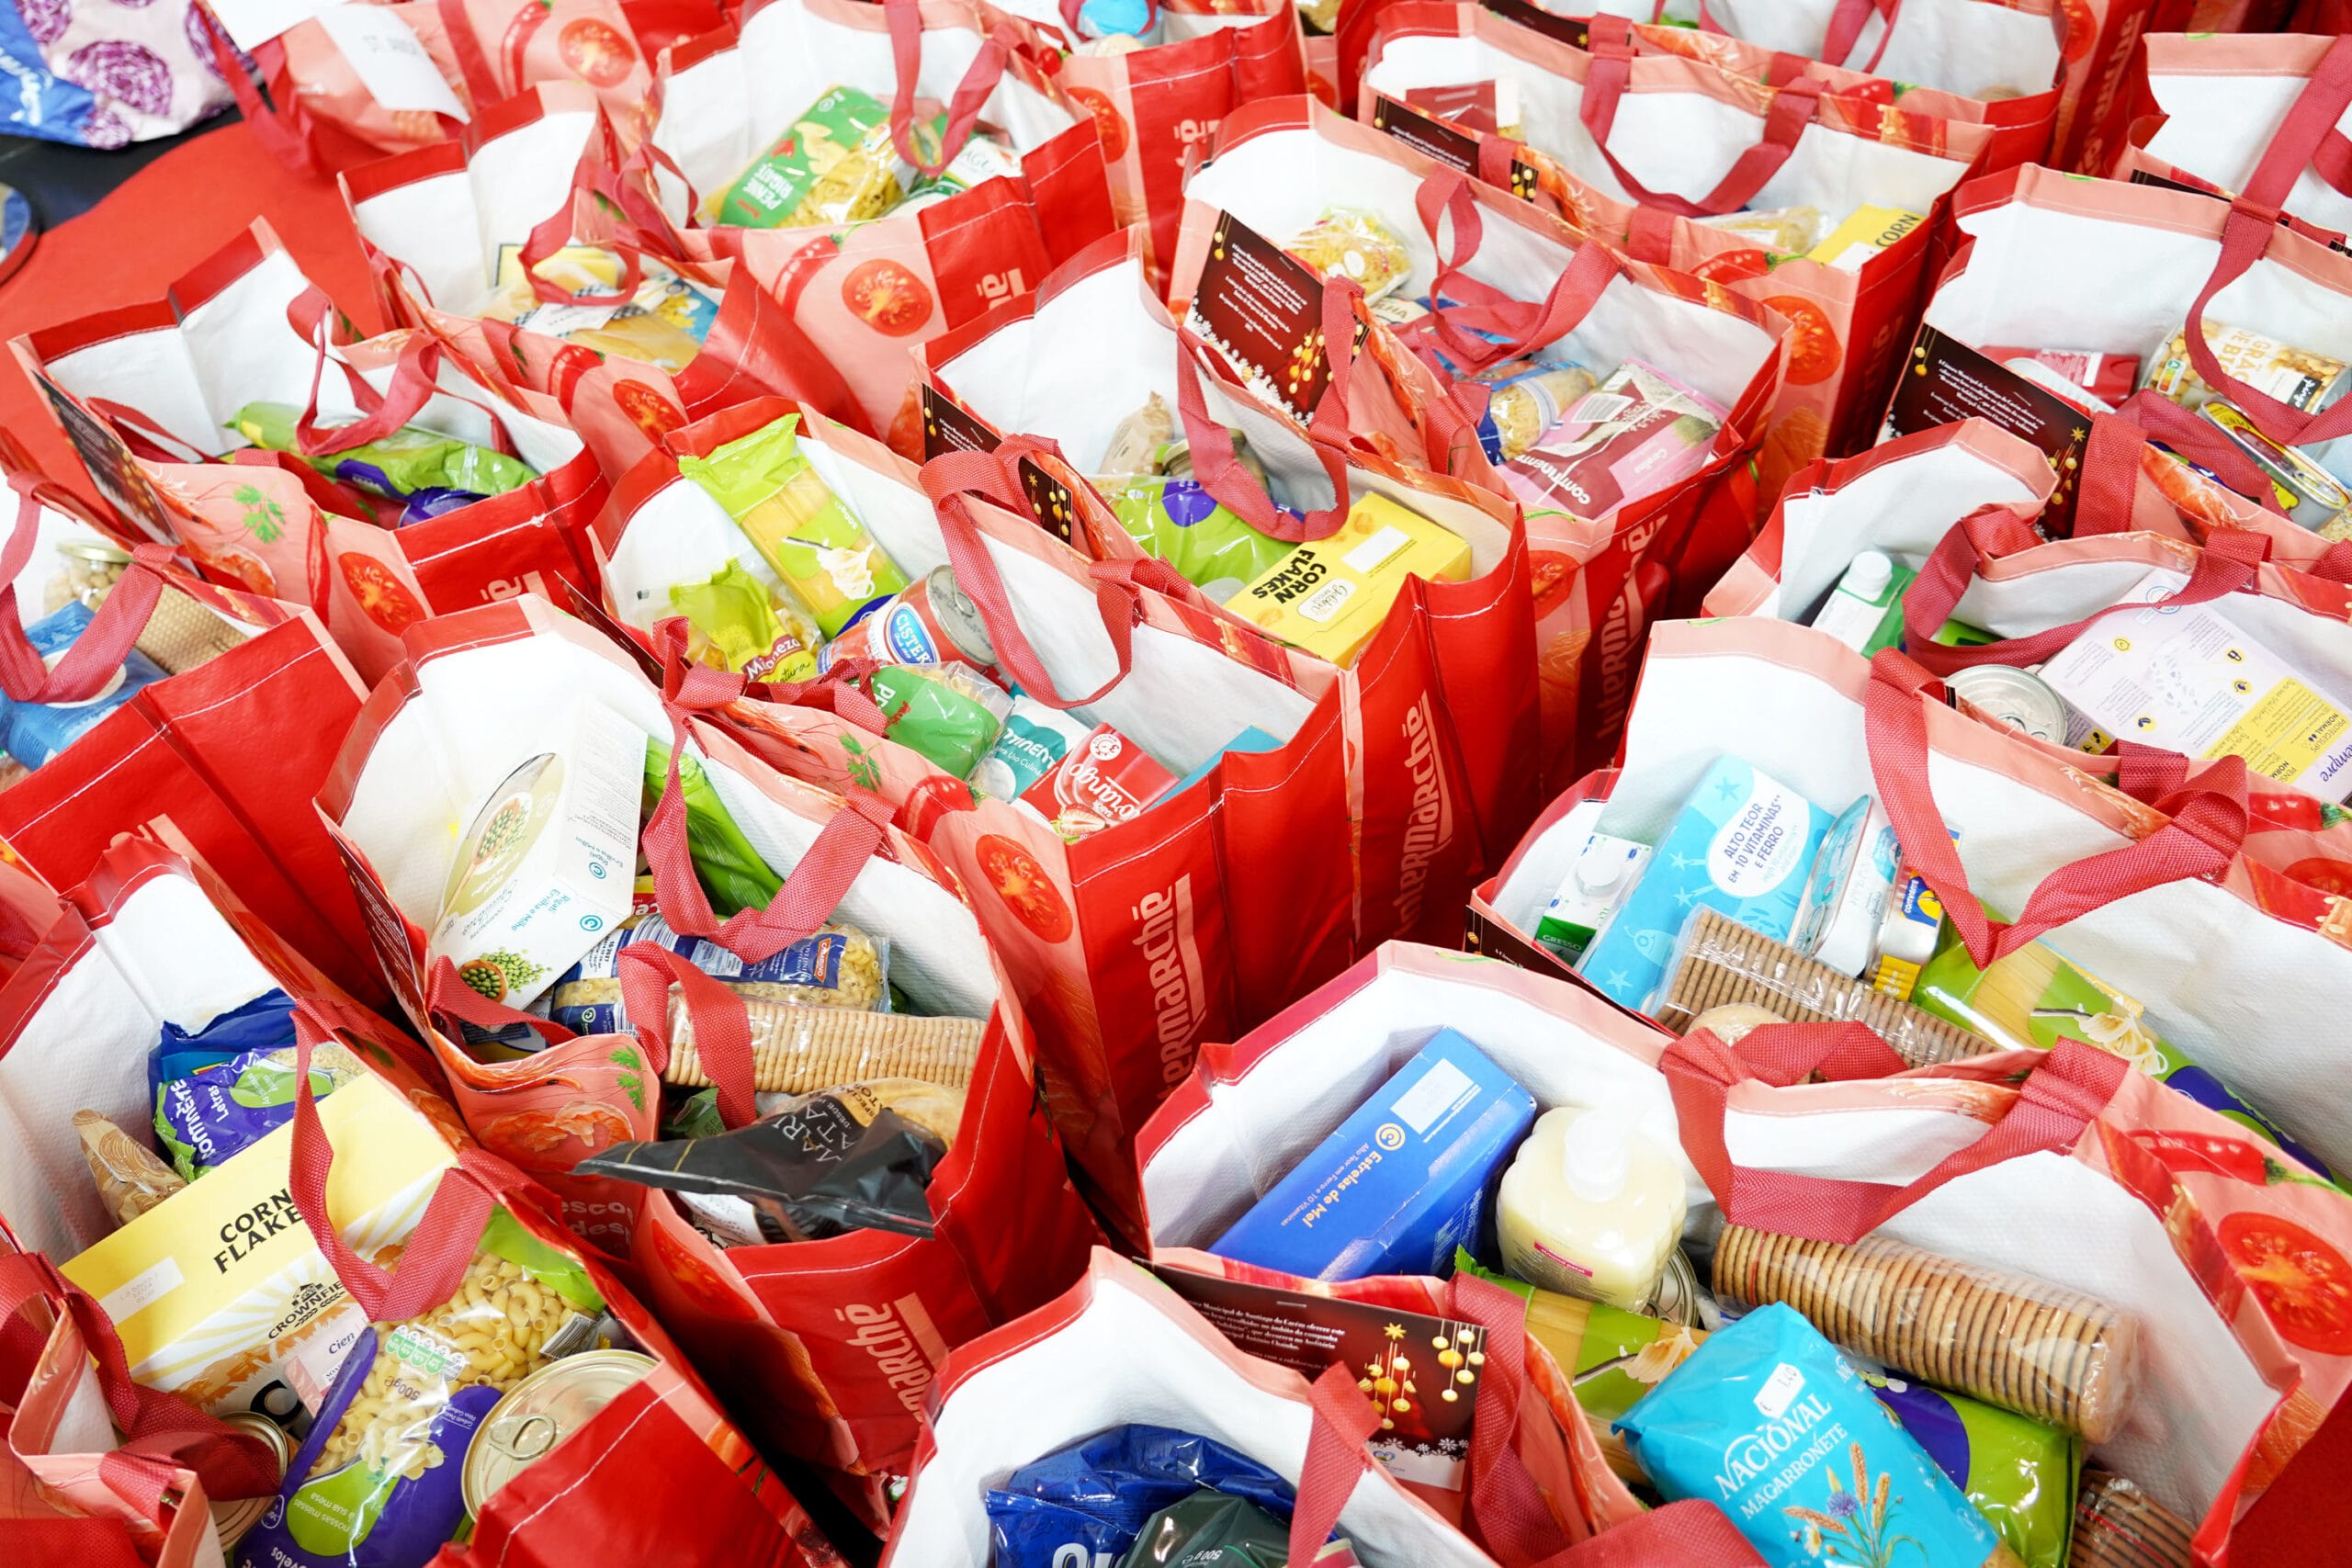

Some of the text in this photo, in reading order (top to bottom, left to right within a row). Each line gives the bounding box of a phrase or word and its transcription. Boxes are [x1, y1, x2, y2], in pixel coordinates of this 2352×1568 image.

[1874, 213, 1921, 247] CORN
[1252, 549, 1316, 599] FLAKES
[1274, 562, 1327, 604] CORN
[896, 613, 933, 663] CISTER
[1722, 802, 1763, 859] ALTO TEOR
[1756, 824, 1784, 861] FERRO
[1727, 869, 1740, 883] EM
[1734, 853, 1749, 869] 10
[1753, 860, 1763, 869] E
[533, 886, 560, 912] Ervilha
[510, 911, 533, 934] Milho
[208, 1085, 230, 1122] Letras
[1342, 1152, 1359, 1168] Teor
[1354, 1141, 1370, 1156] Alto
[1300, 1148, 1384, 1229] Estrelas de Mel
[1306, 1191, 1317, 1203] 10
[1318, 1172, 1338, 1191] Ferro
[220, 1188, 292, 1243] CORN
[1279, 1199, 1310, 1228] Vitaminas
[213, 1205, 303, 1274] FLAKE
[267, 1280, 346, 1339] CROWNFIE
[328, 1332, 355, 1355] Cien
[834, 1303, 932, 1423] marché
[1713, 1393, 1833, 1500] NACIONAL
[1740, 1423, 1849, 1521] MACARRONETE
[291, 1497, 322, 1518] massas
[308, 1491, 334, 1508] mesa
[331, 1502, 348, 1516] sua
[319, 1512, 351, 1533] nossas
